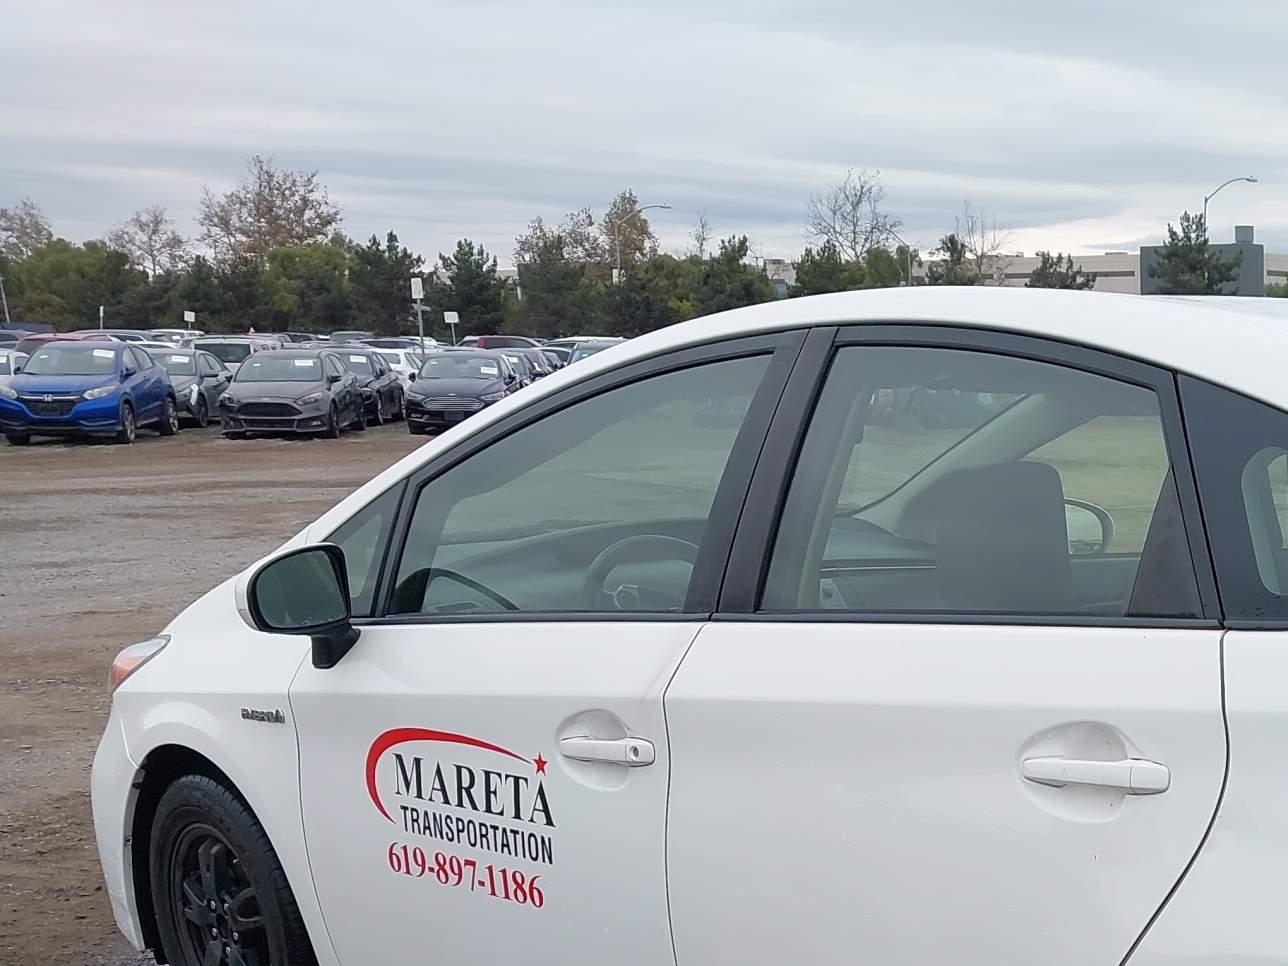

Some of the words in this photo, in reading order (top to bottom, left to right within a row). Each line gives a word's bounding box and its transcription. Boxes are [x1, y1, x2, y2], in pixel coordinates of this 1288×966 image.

[392, 752, 556, 828] MARETA
[400, 804, 553, 866] TRANSPORTATION
[388, 842, 544, 908] 619-897-1186
